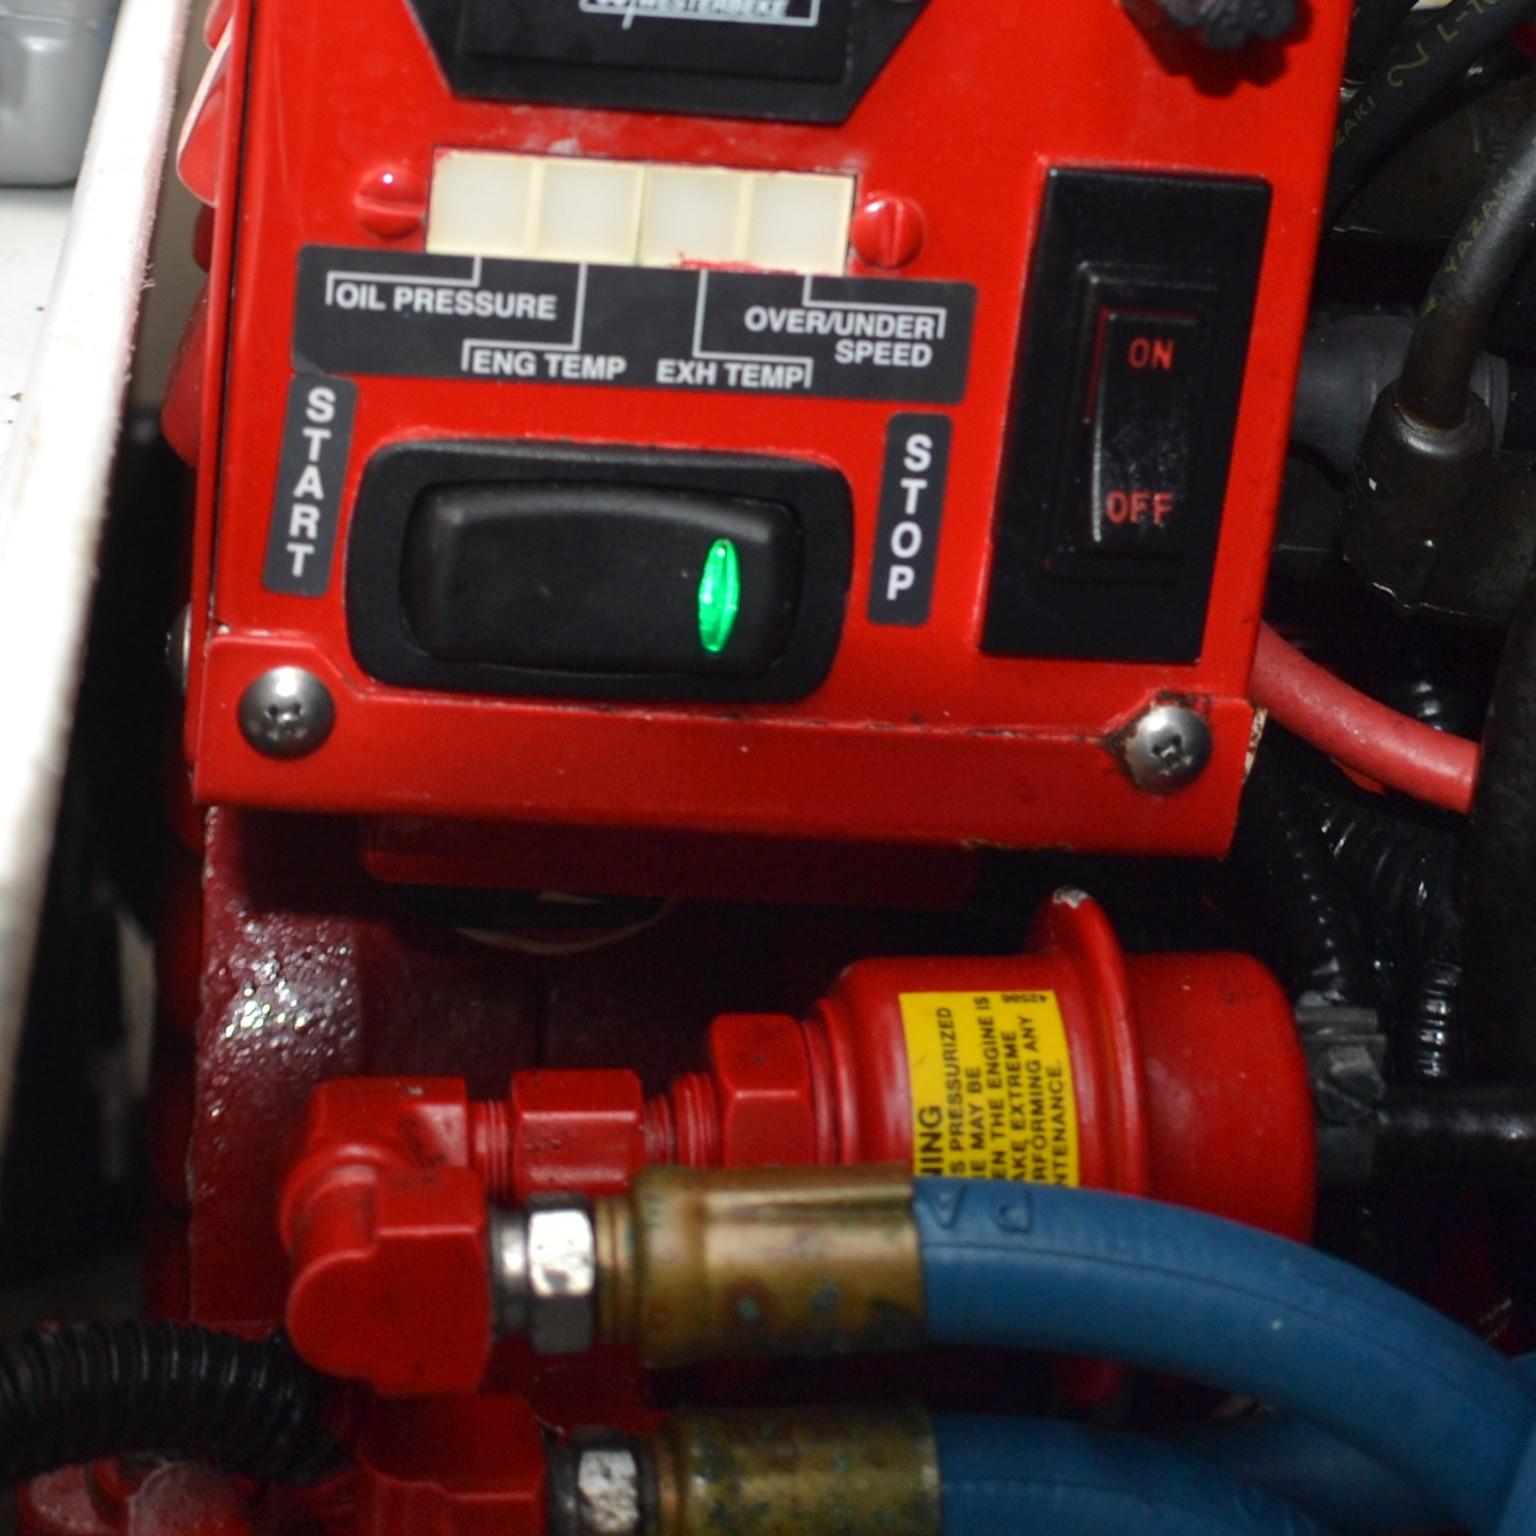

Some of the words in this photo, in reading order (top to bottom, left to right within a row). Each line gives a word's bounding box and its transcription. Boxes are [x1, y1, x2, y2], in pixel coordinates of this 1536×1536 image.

[335, 281, 386, 311] OIL
[393, 286, 558, 320] PRESSURE
[743, 305, 936, 340] OVER/UNDER
[472, 349, 537, 376] ENG
[544, 353, 627, 381] TEMP
[833, 339, 934, 368] SPEED
[1127, 337, 1175, 370] ON
[656, 357, 718, 386] EXH
[723, 362, 804, 390] TEMP
[285, 386, 337, 578] START
[886, 432, 934, 601] STOP
[1105, 488, 1175, 526] OFF
[973, 996, 991, 1011] IS
[978, 1016, 1003, 1090] ENGINE
[1018, 1015, 1039, 1053] ANY
[936, 1006, 964, 1152] PRESSURIZED
[965, 1066, 983, 1094] BE
[1001, 1031, 1026, 1131] EXTREME
[968, 1103, 985, 1151] MAY
[988, 1098, 1006, 1141] THE
[1025, 1059, 1048, 1181] RFORMING
[991, 1150, 1008, 1179] EN
[1011, 1139, 1028, 1181] AKE
